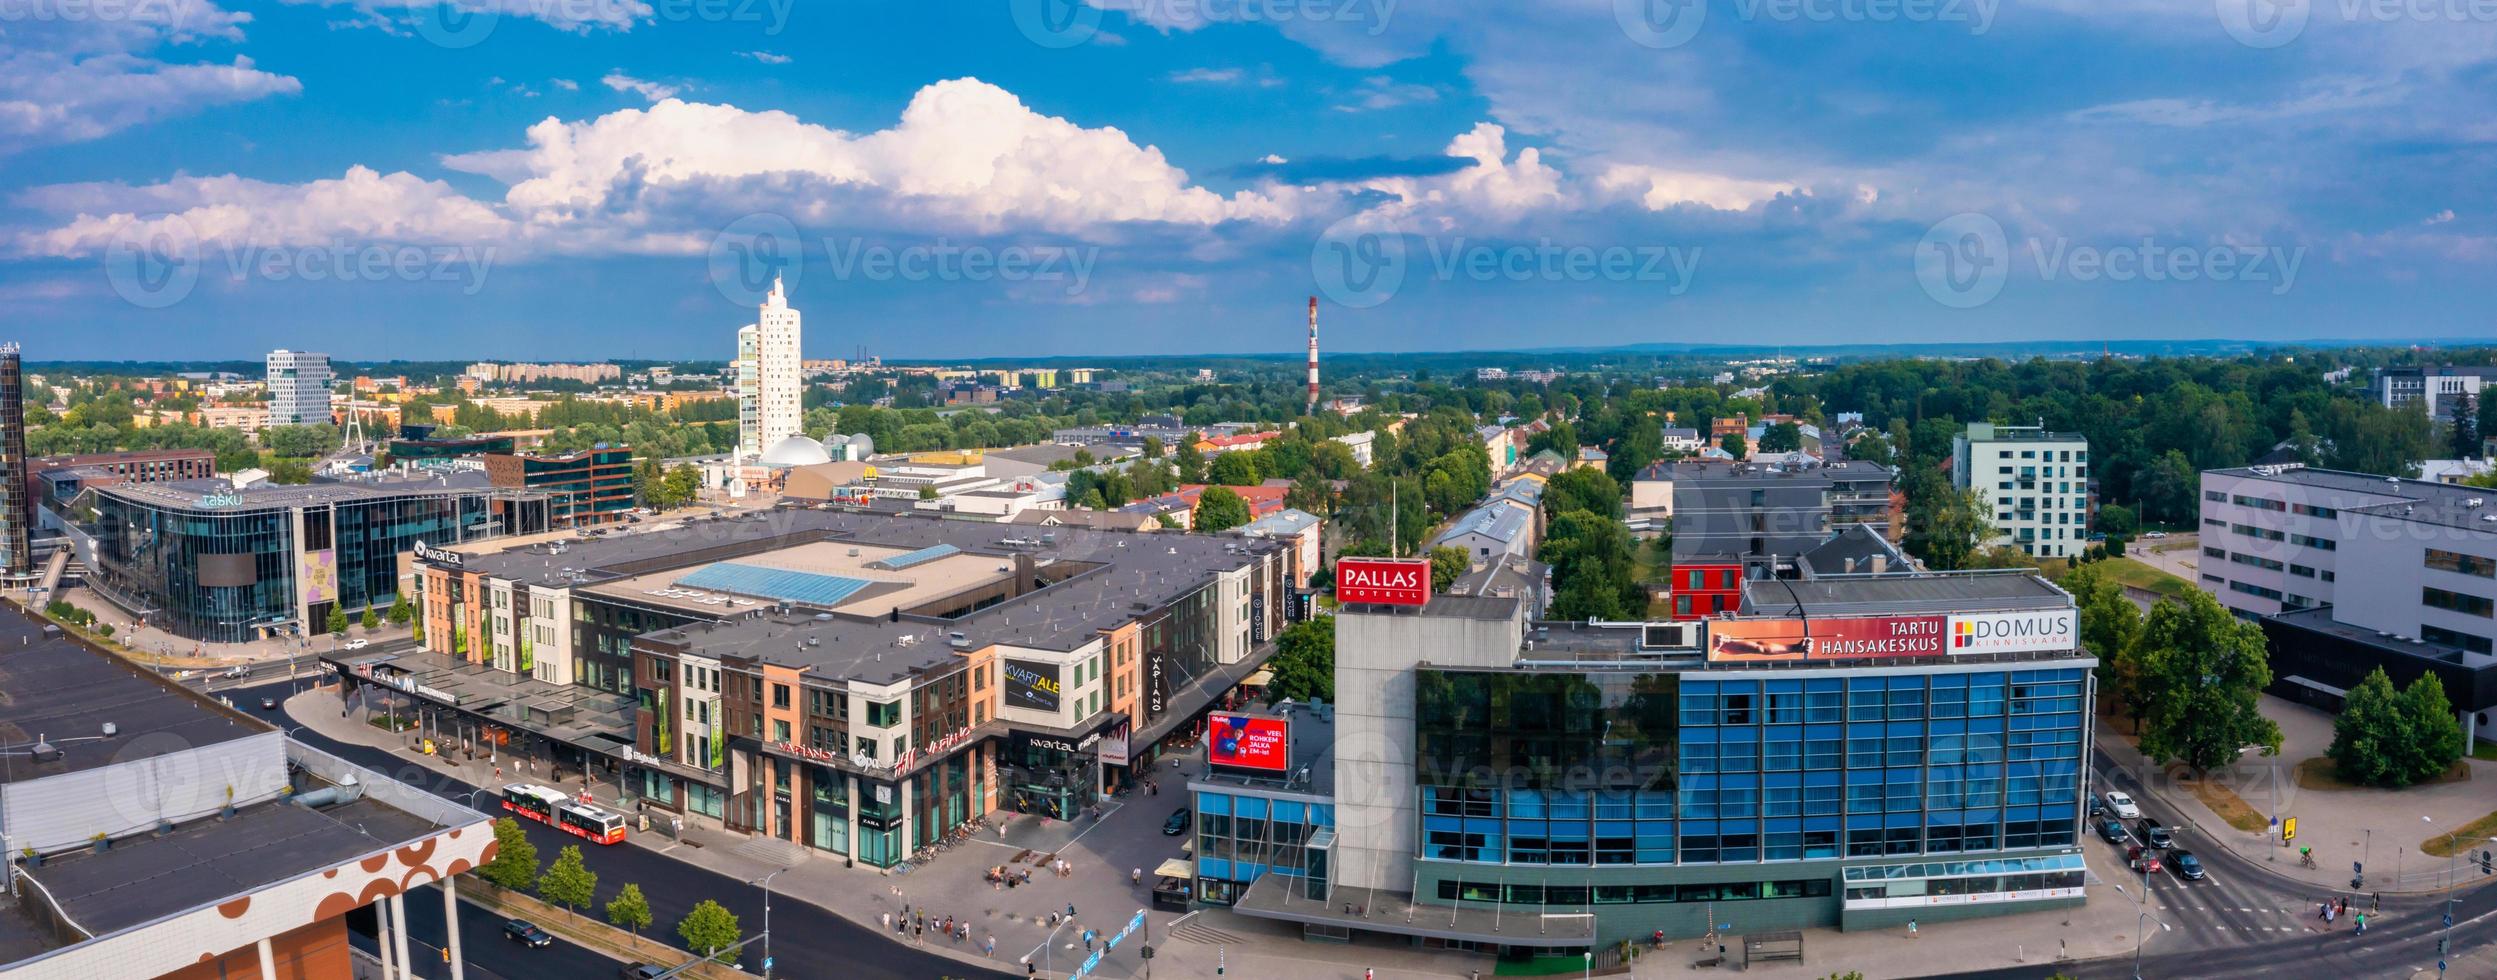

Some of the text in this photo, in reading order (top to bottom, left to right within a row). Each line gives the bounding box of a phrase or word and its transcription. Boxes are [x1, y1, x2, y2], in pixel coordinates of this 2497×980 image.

[1345, 569, 1417, 588] PALLAS
[1345, 590, 1417, 598] HOTELL
[1890, 621, 1939, 636] TARTU
[1976, 617, 2068, 638] DOMUS
[1821, 637, 1939, 655] HANSAKESKUS
[1975, 636, 2068, 647] KINNISVARA
[1005, 663, 1060, 694] KVARTALE
[1249, 735, 1279, 743] ROHKEM
[776, 795, 790, 803] ZARA
[862, 819, 880, 827] ZARA
